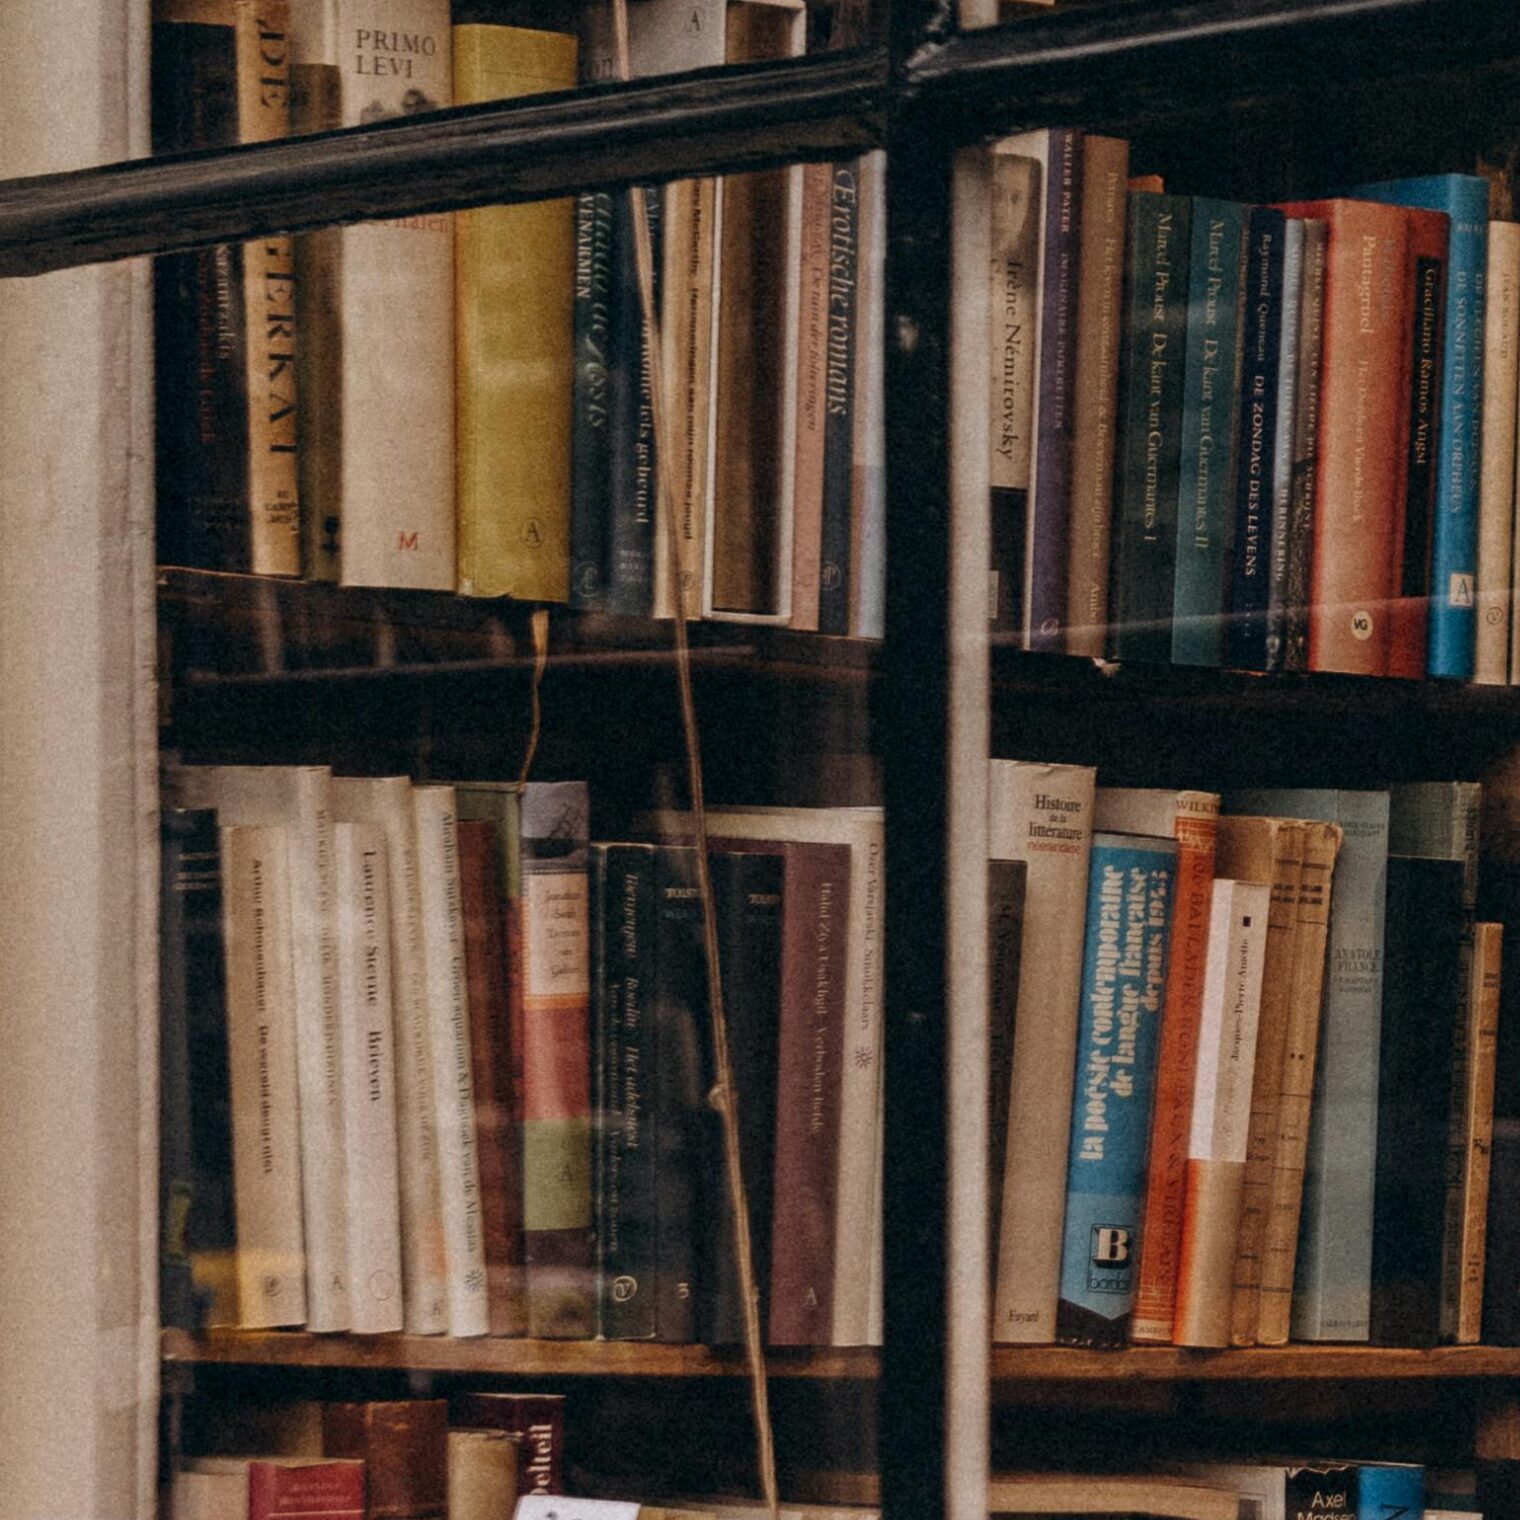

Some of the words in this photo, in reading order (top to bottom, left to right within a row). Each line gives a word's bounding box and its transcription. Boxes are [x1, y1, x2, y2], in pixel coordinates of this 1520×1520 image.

[355, 28, 438, 58] PRIMO
[355, 54, 415, 79] LEVI
[1156, 212, 1173, 266] Marcel
[1205, 217, 1225, 271] Marcel
[1256, 233, 1272, 297] Raymond
[1153, 271, 1171, 323] Proust
[1204, 276, 1222, 328] Proust
[1420, 267, 1437, 354] Graciliano
[1152, 331, 1169, 358] De
[1203, 337, 1220, 362] De
[1150, 359, 1168, 399] kant
[1200, 364, 1219, 401] kant
[1251, 374, 1265, 397] DE
[1417, 357, 1434, 415] Ramos
[1148, 404, 1163, 431] van
[1199, 406, 1214, 433] van
[1247, 402, 1264, 475] ZONDAG
[1413, 418, 1430, 465] Angst
[1144, 431, 1166, 530] Guermantes
[1194, 433, 1215, 532] Guermantes
[1247, 479, 1261, 511] DES
[1243, 515, 1261, 578] LEVENS
[1034, 793, 1082, 814] Histoire
[1028, 822, 1083, 842] littérature
[361, 849, 379, 942] Laurence
[364, 945, 381, 1008] Sterne
[1091, 864, 1124, 1047] contemporaine
[1110, 983, 1139, 1065] langue
[366, 1029, 383, 1104] Brieven
[1082, 1049, 1111, 1132] poésie
[1109, 1068, 1134, 1099] de
[1079, 1136, 1104, 1162] la
[1311, 1490, 1348, 1510] Axel
